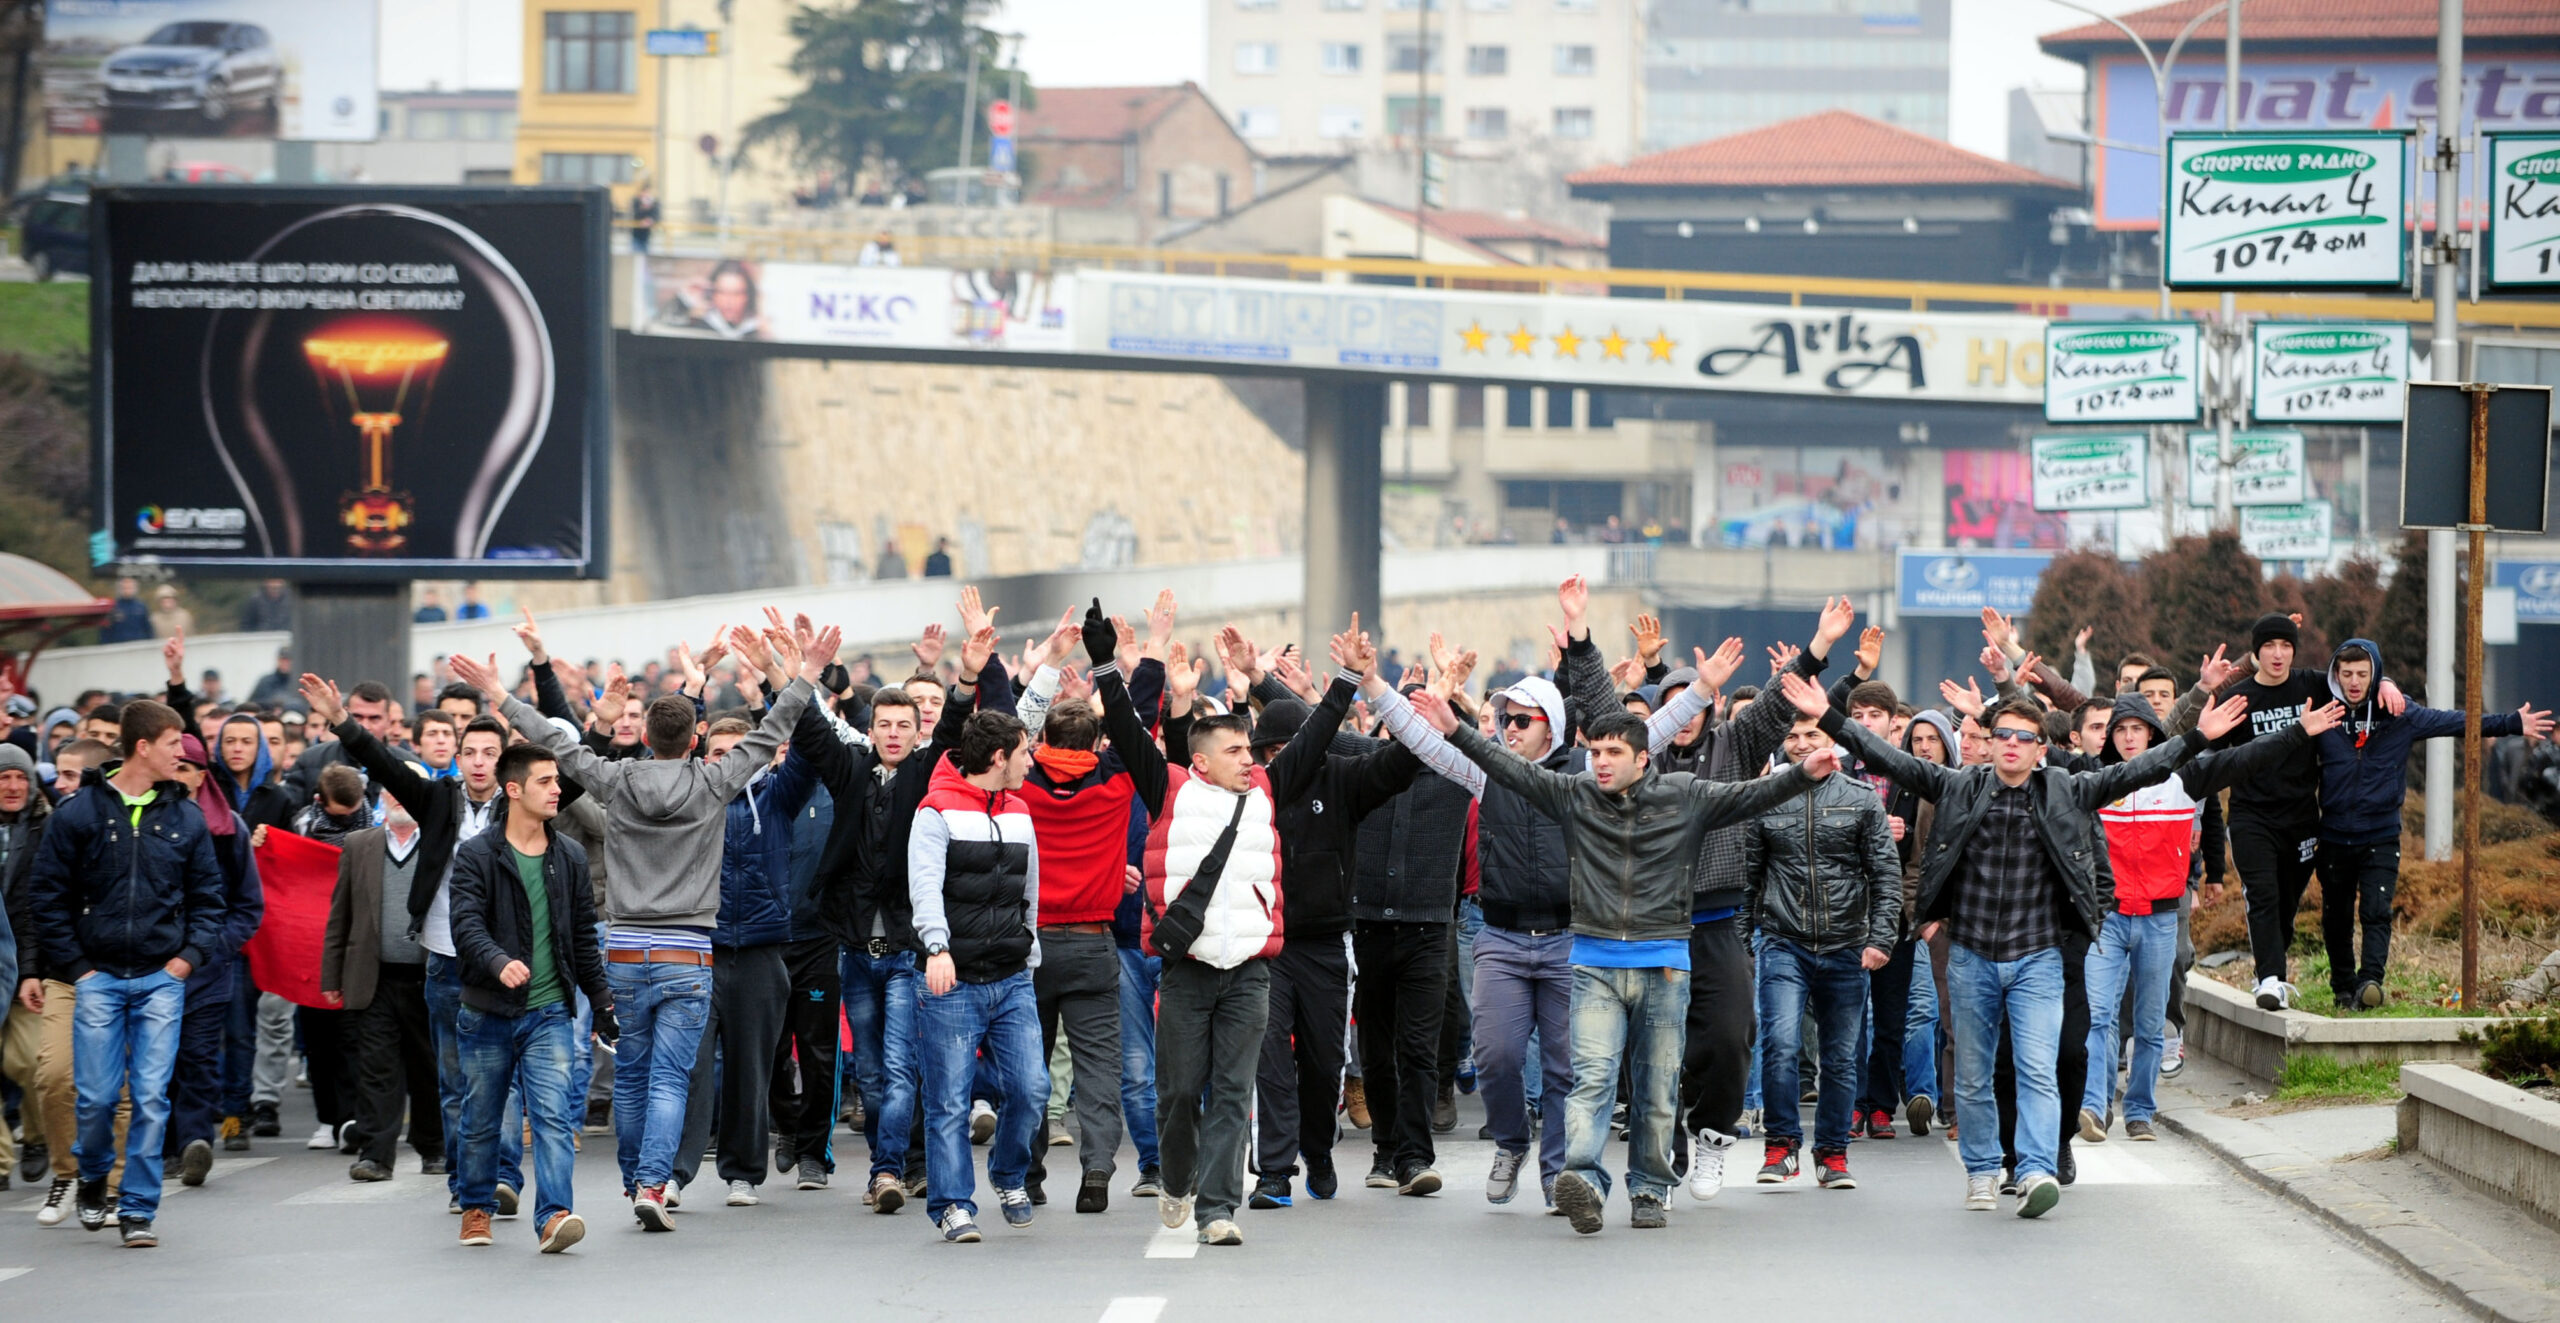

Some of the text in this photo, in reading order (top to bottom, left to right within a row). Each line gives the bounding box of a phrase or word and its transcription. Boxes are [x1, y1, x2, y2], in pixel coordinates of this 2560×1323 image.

[2165, 66, 2370, 123] mat
[2190, 153, 2292, 172] СПОРТСКО
[2346, 170, 2375, 217] 4
[2213, 230, 2317, 274] 107,4
[2251, 706, 2293, 724] MADE
